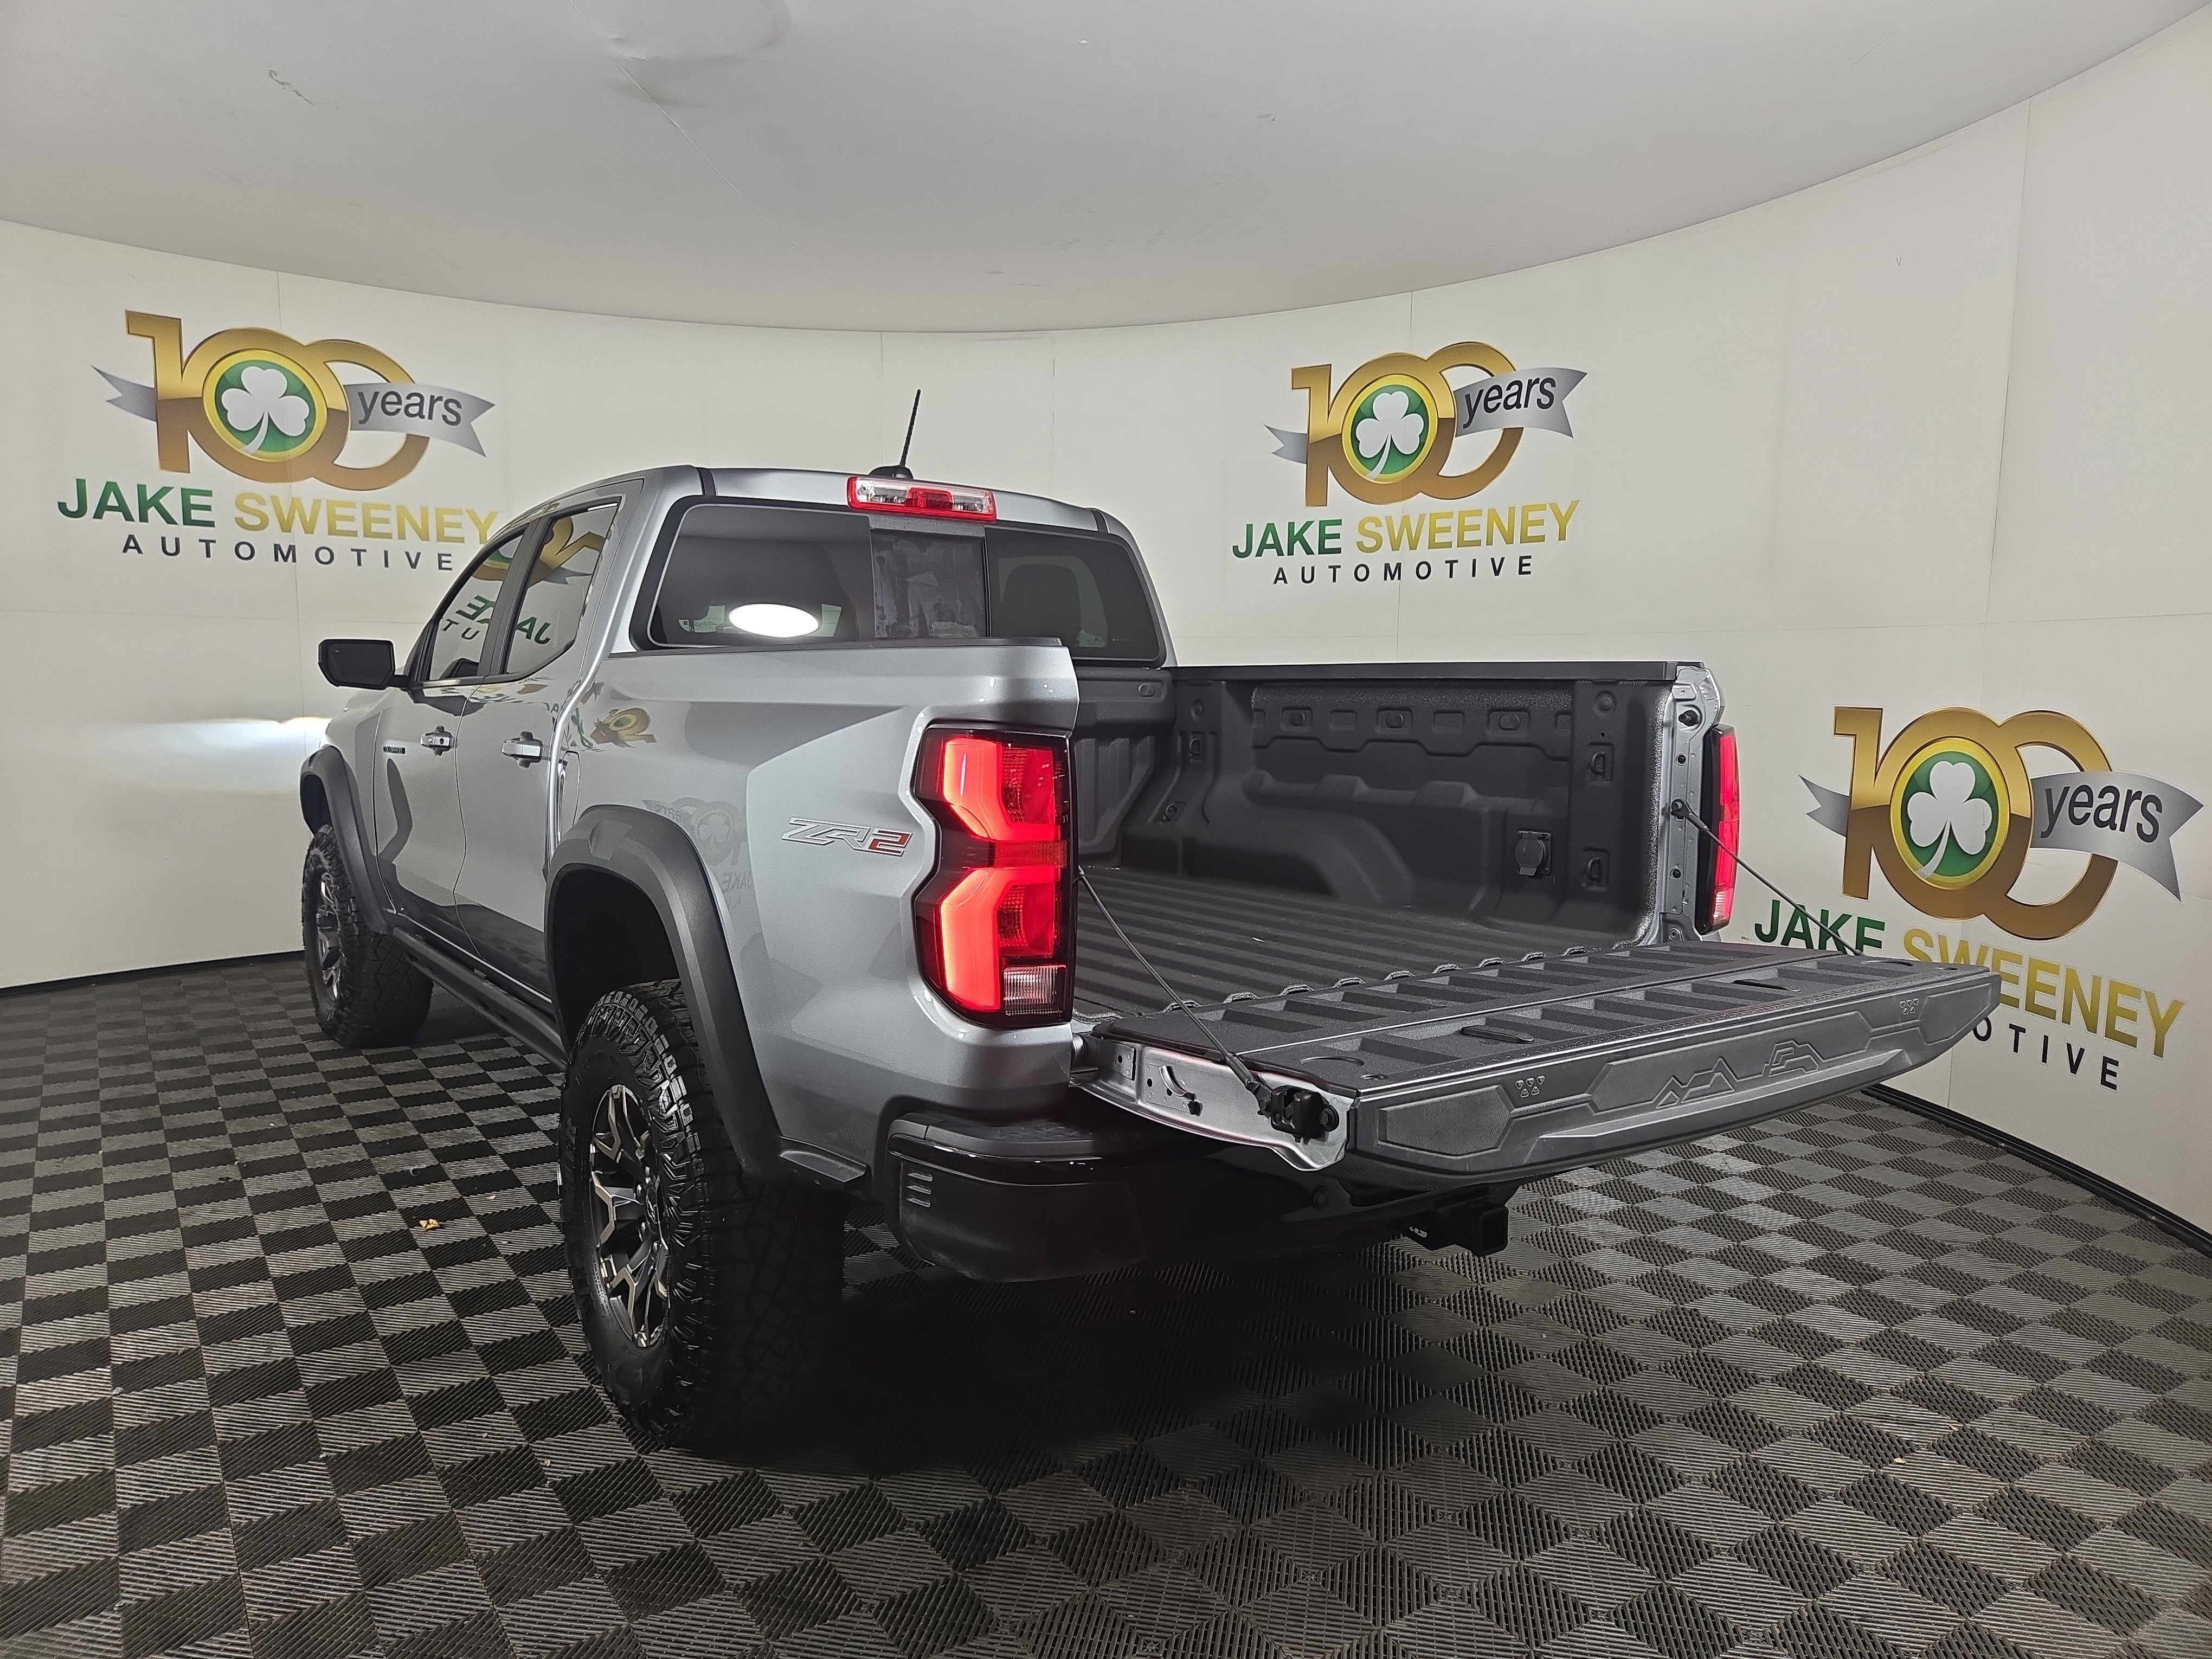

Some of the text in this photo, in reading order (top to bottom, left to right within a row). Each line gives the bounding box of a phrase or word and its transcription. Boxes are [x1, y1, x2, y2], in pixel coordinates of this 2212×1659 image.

[124, 310, 430, 491] 100
[357, 389, 463, 427] years
[1291, 341, 1524, 507] 100
[1463, 376, 1557, 429] years
[57, 478, 501, 545] JAKE SWEENEY
[1232, 500, 1580, 558] JAKE SWEENEY
[122, 533, 453, 571] AUTOMOTIVE
[1273, 555, 1533, 586] AUTOMOTIVE
[781, 817, 913, 857] ZR2
[1834, 706, 2119, 941] 100
[2040, 783, 2163, 844] years
[1972, 1016, 2120, 1091] OTIVE
